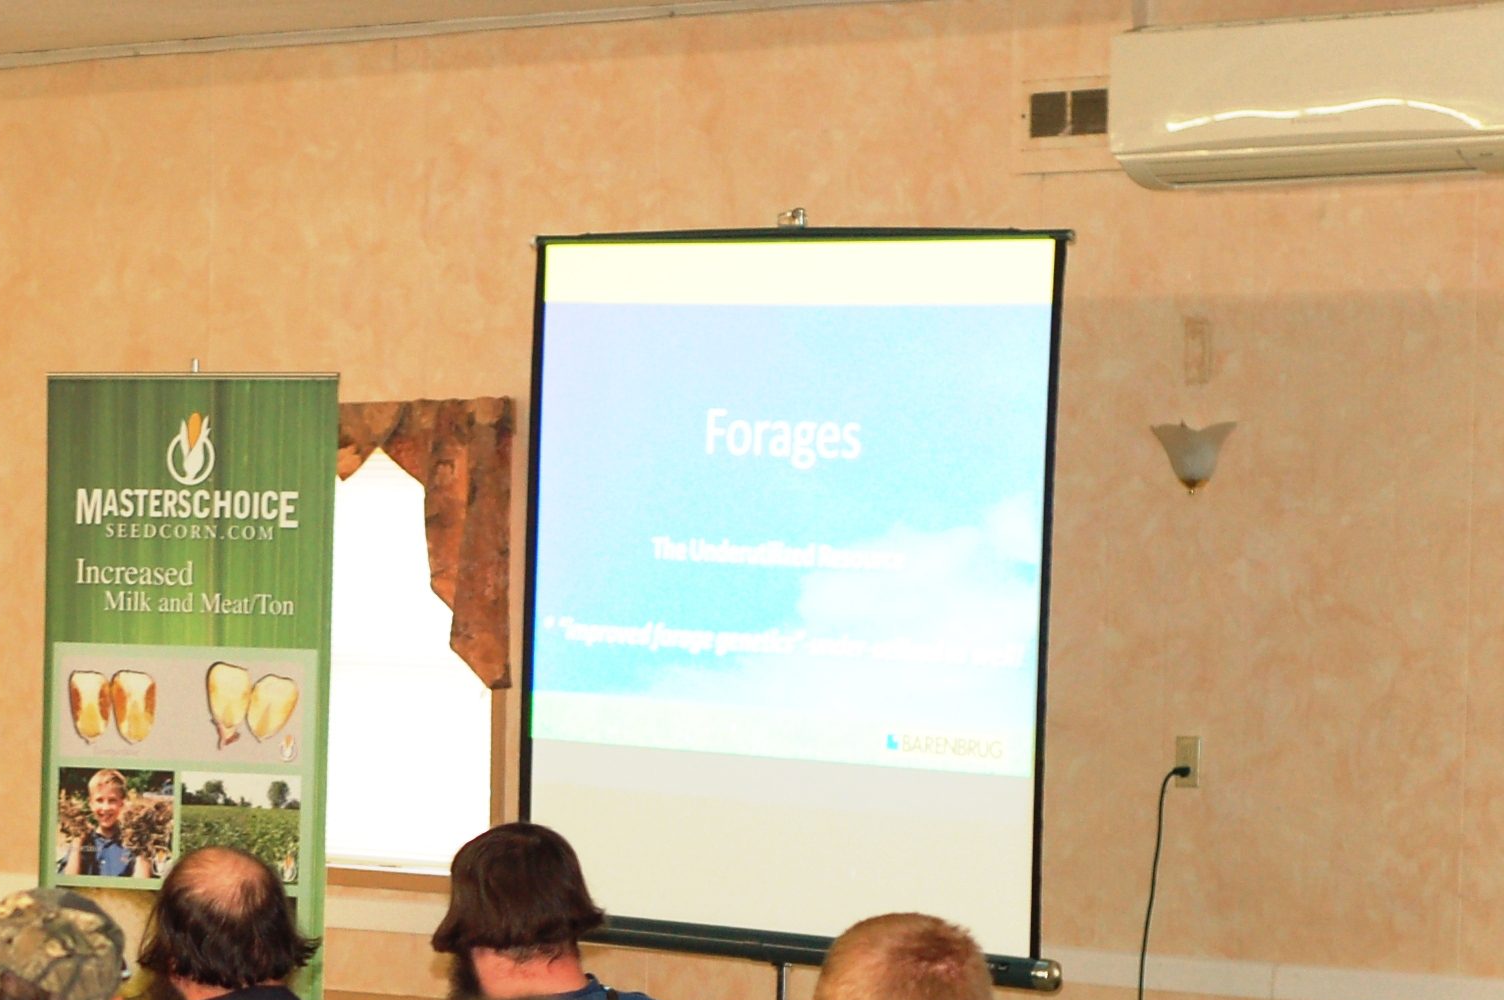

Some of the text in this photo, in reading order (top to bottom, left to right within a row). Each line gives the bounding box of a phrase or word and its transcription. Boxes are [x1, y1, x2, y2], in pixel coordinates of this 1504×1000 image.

[705, 408, 863, 471] Forages
[75, 488, 299, 528] MASTERSCHOICE
[105, 522, 274, 541] SEEDCORN.COM
[75, 558, 193, 587] Increased
[104, 590, 294, 616] Milk and Meat/Ton
[901, 733, 1003, 760] BARENBRUG
